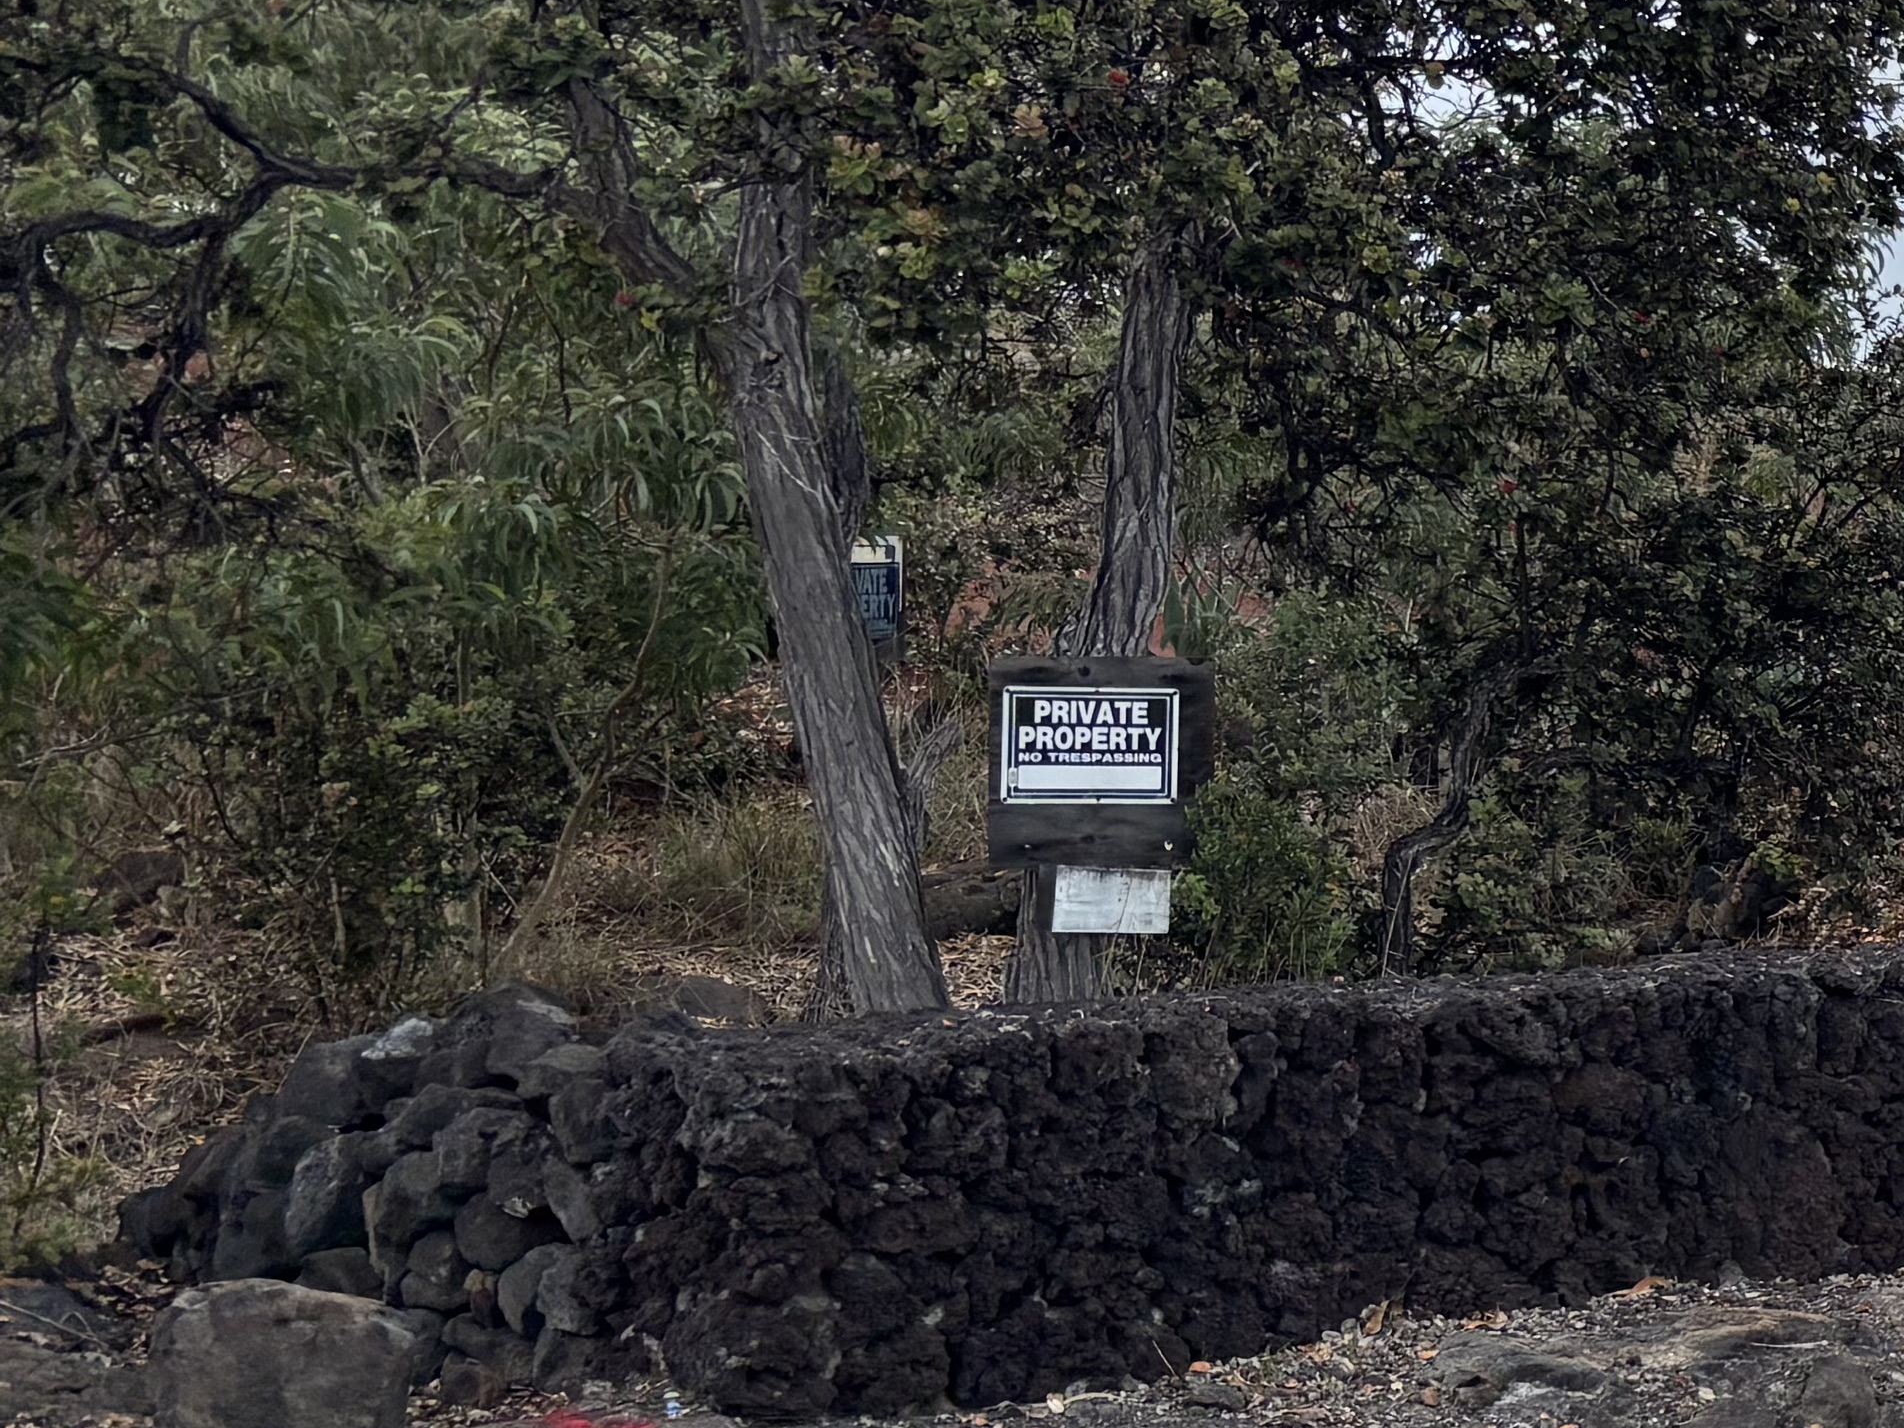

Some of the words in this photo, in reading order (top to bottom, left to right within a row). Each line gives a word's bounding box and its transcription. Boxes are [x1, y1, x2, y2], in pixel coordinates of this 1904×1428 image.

[855, 568, 888, 594] VATE
[860, 593, 896, 618] ERTY
[1034, 699, 1149, 725] PRIVATE
[1018, 725, 1162, 751] PROPERTY
[1018, 752, 1043, 763] NO
[1047, 752, 1162, 763] TRESPASSING
